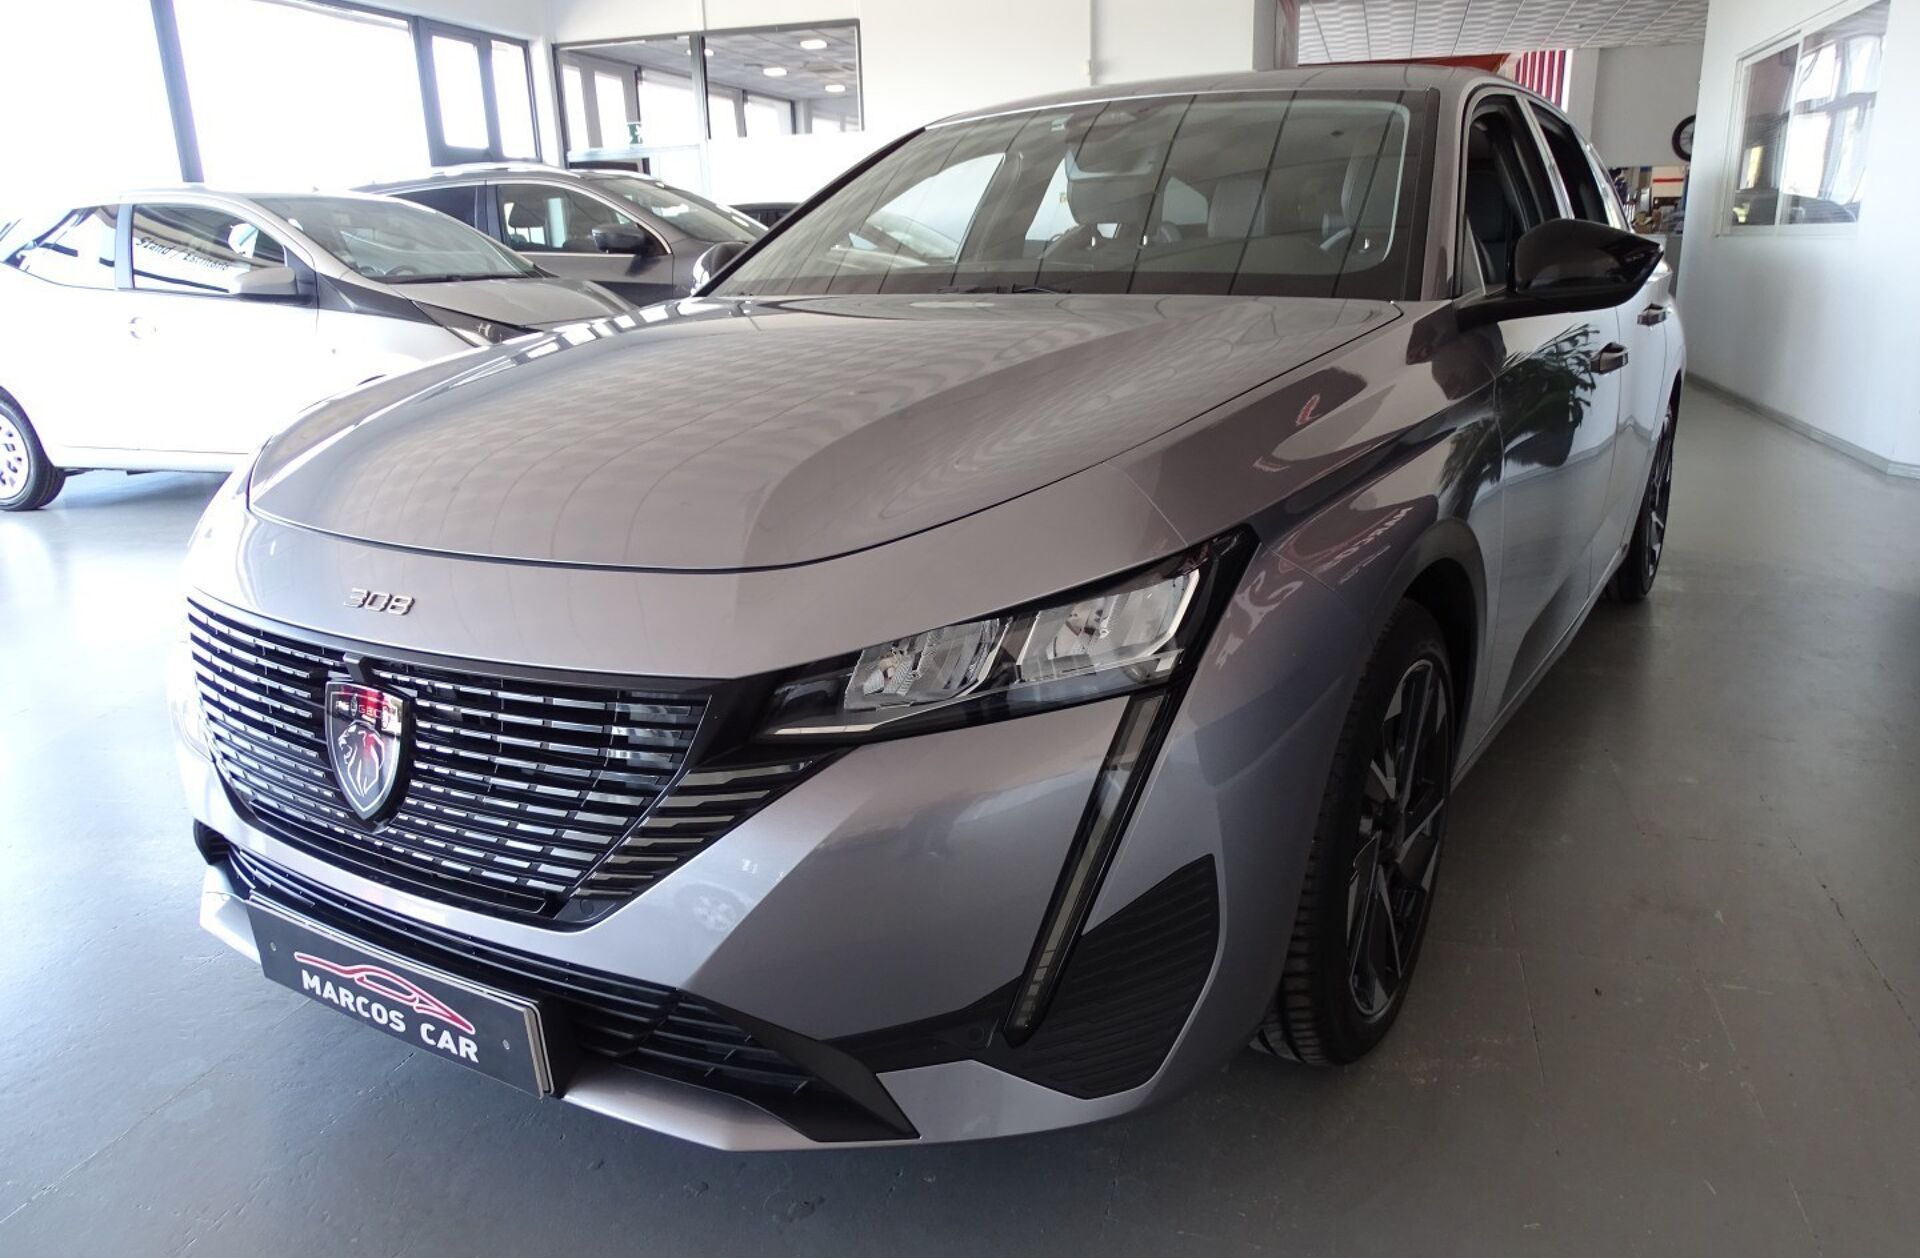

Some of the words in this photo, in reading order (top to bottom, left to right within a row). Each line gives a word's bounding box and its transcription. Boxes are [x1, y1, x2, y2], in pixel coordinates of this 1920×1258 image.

[136, 236, 176, 255] Stand
[344, 587, 415, 615] 308
[301, 969, 406, 1033] MARCOS
[419, 1022, 479, 1063] CAR
